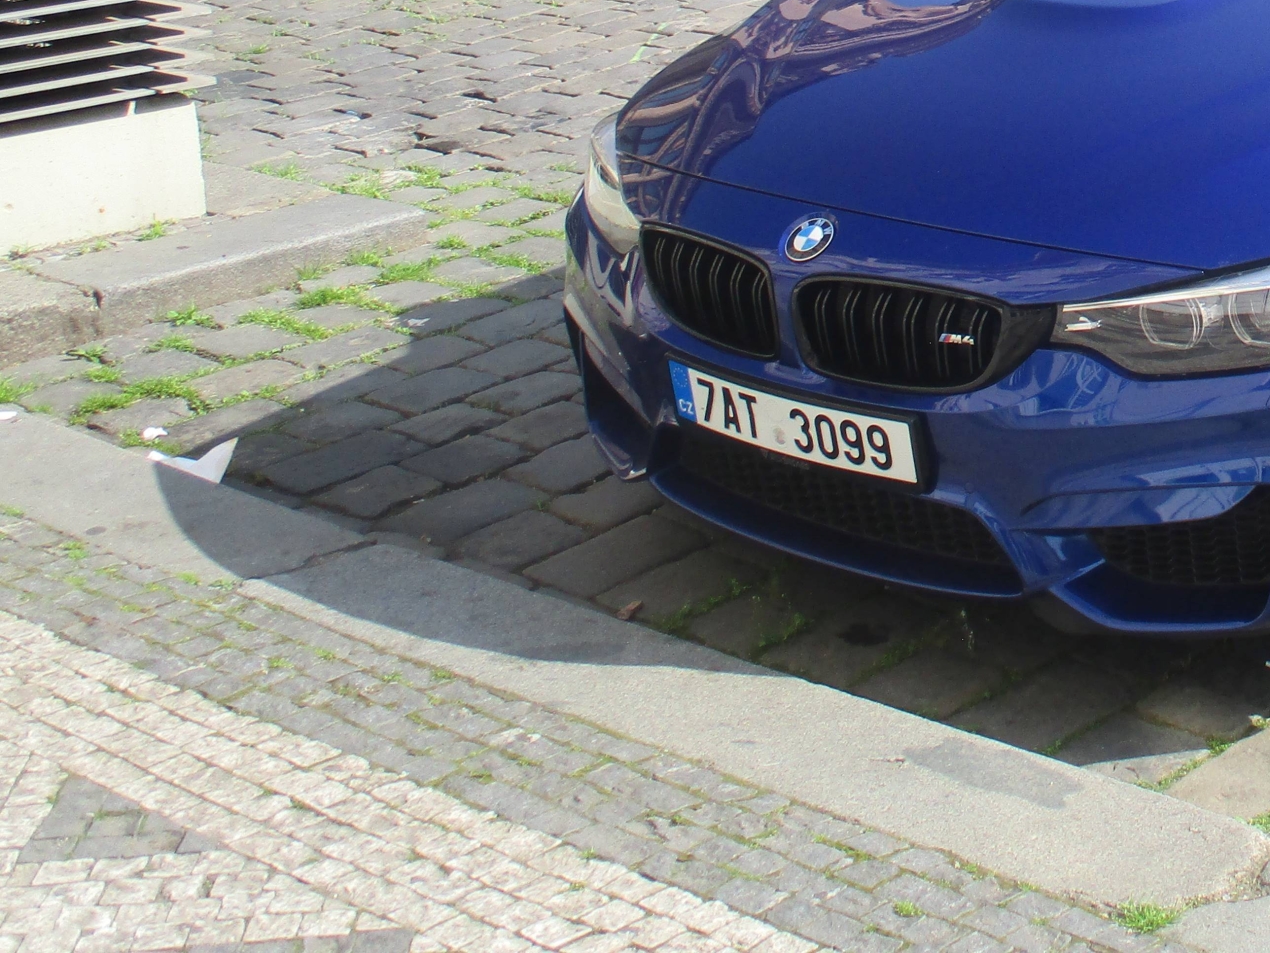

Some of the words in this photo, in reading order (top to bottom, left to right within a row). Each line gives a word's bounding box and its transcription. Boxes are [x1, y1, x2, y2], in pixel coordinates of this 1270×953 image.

[949, 333, 975, 346] M4
[678, 398, 694, 415] CZ
[697, 377, 757, 439] 7AT
[789, 408, 892, 470] 3099
